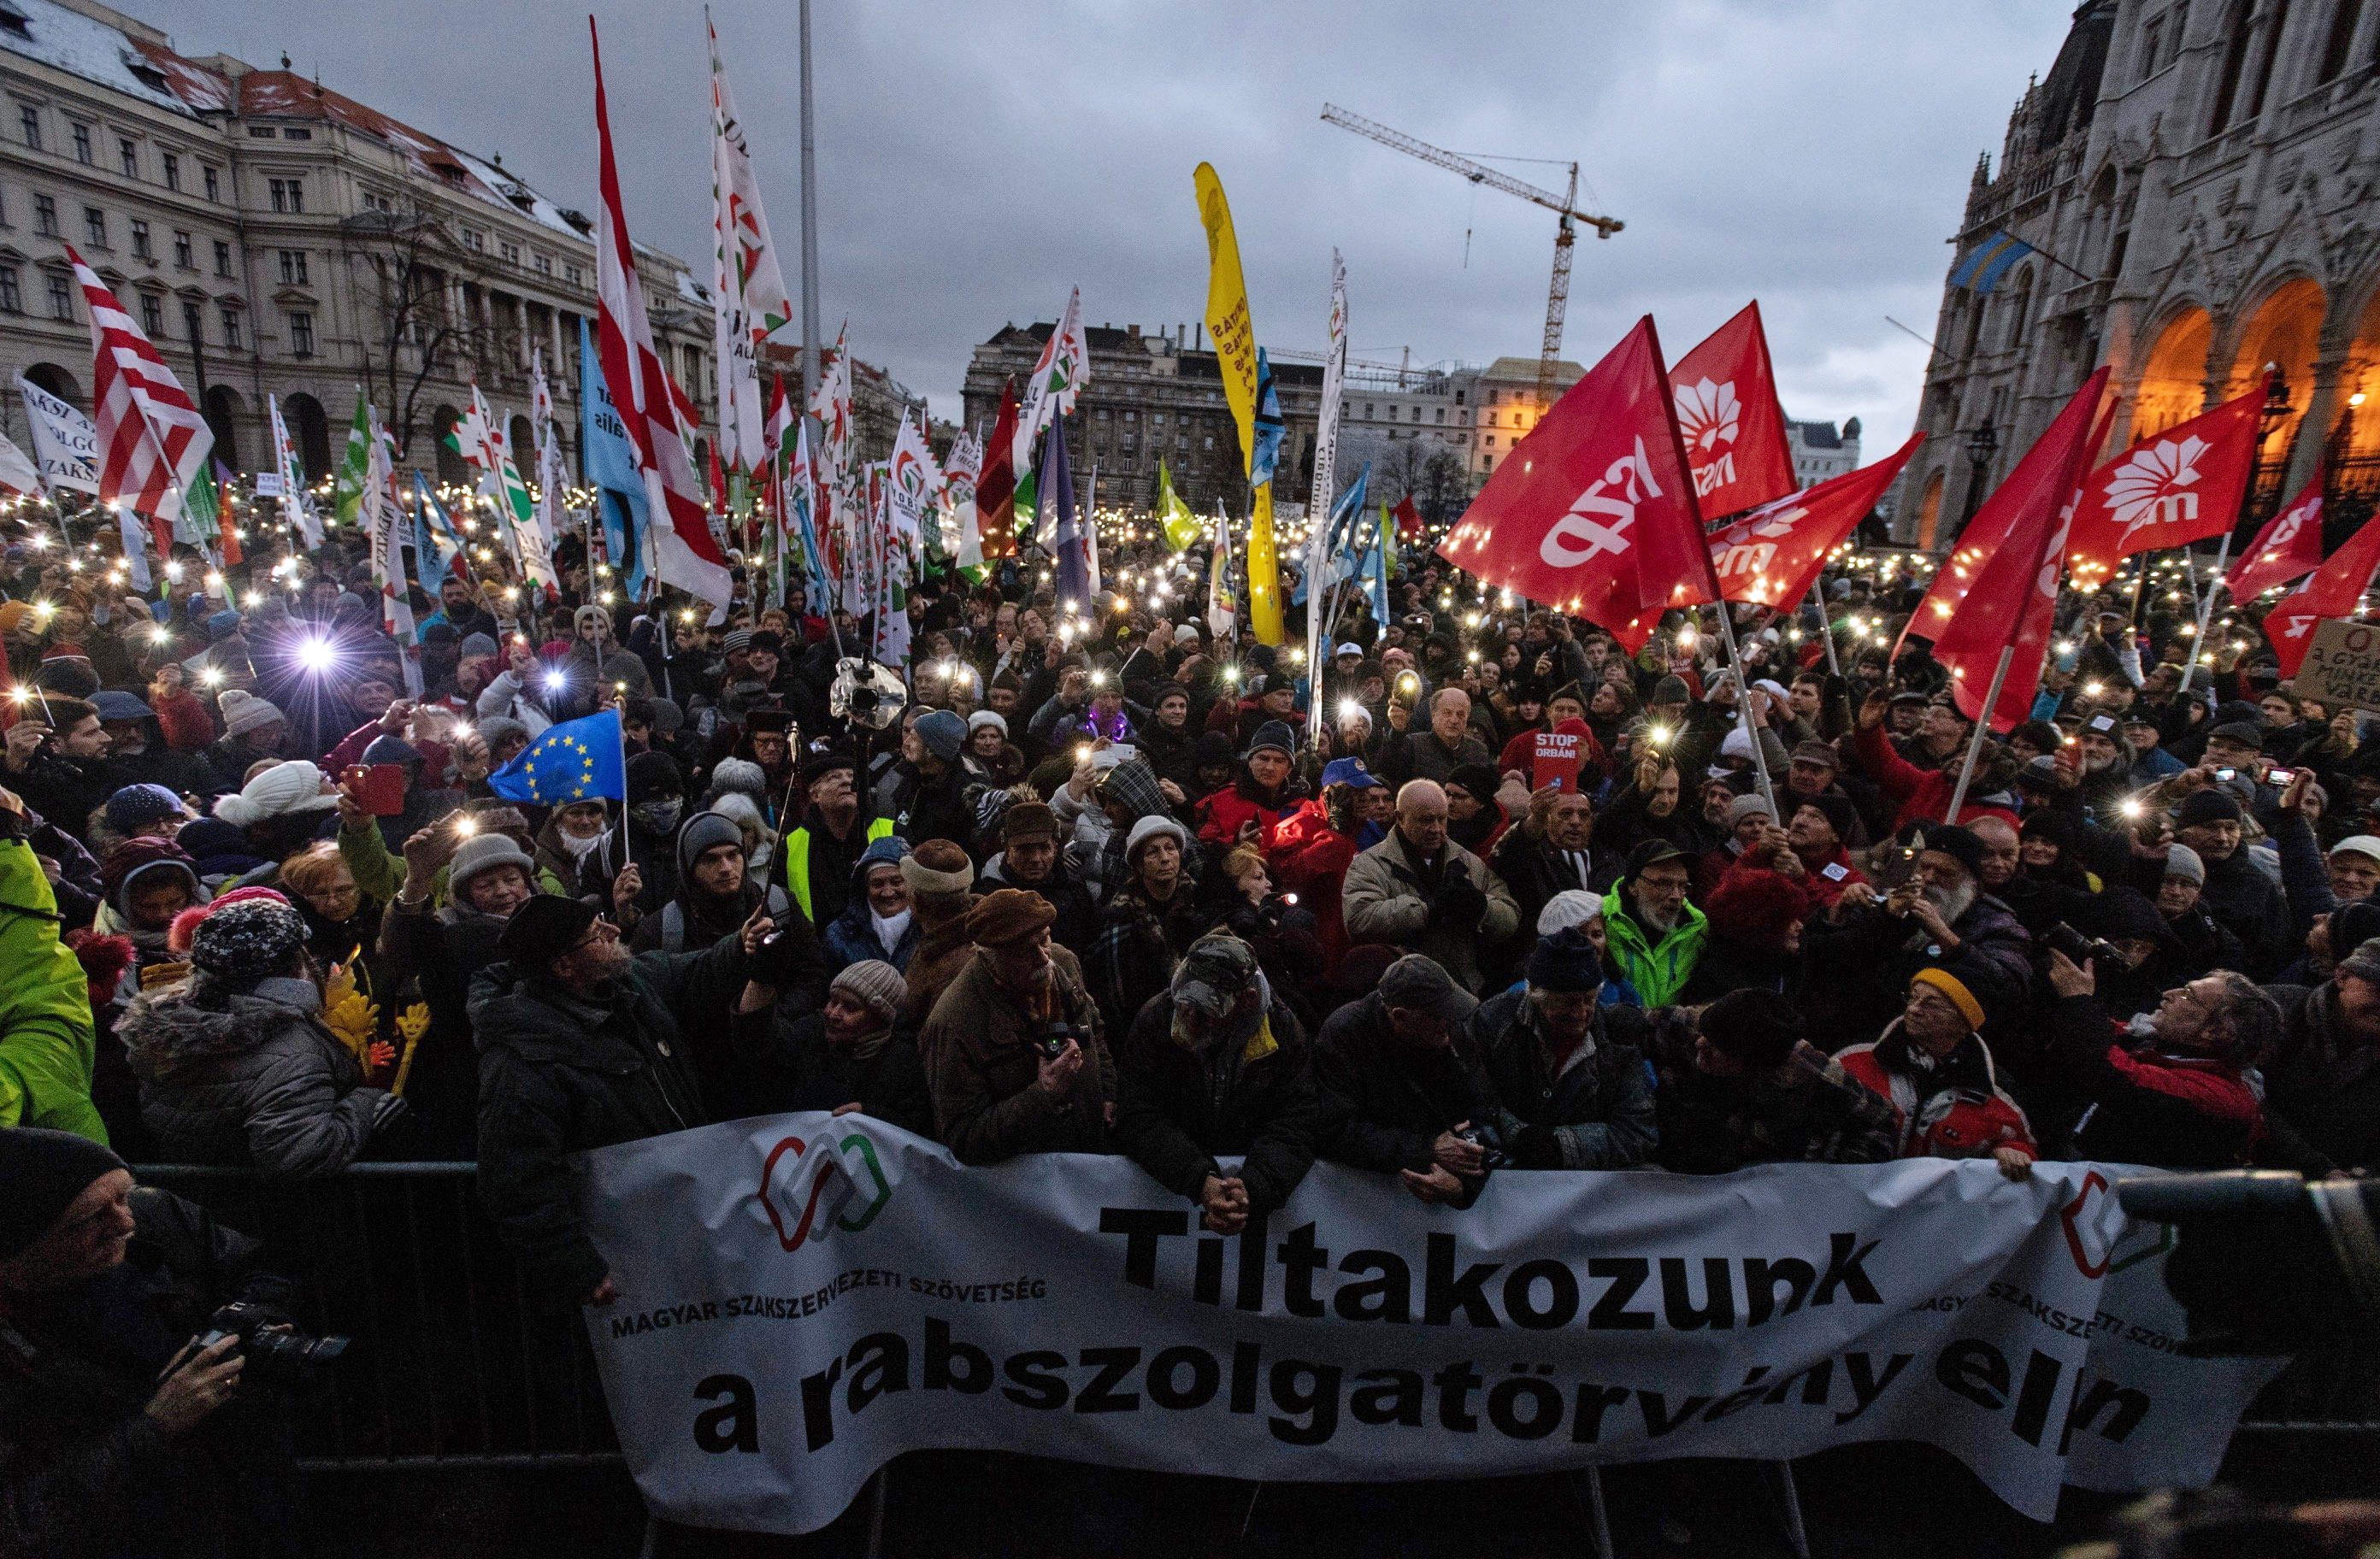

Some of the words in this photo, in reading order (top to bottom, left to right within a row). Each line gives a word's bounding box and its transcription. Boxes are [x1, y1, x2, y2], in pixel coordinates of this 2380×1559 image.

[1535, 733, 1578, 747] STOP
[1535, 747, 1576, 759] ORBÁN!
[611, 1301, 720, 1339] MAGYAR
[725, 1269, 903, 1321] SZAKSZERVEZETI
[909, 1275, 1047, 1303] SZÖVETSÉG
[1099, 1206, 1884, 1332] Tiltakozunk
[692, 1373, 760, 1455] a
[799, 1315, 1914, 1453] rabszolgatörvény
